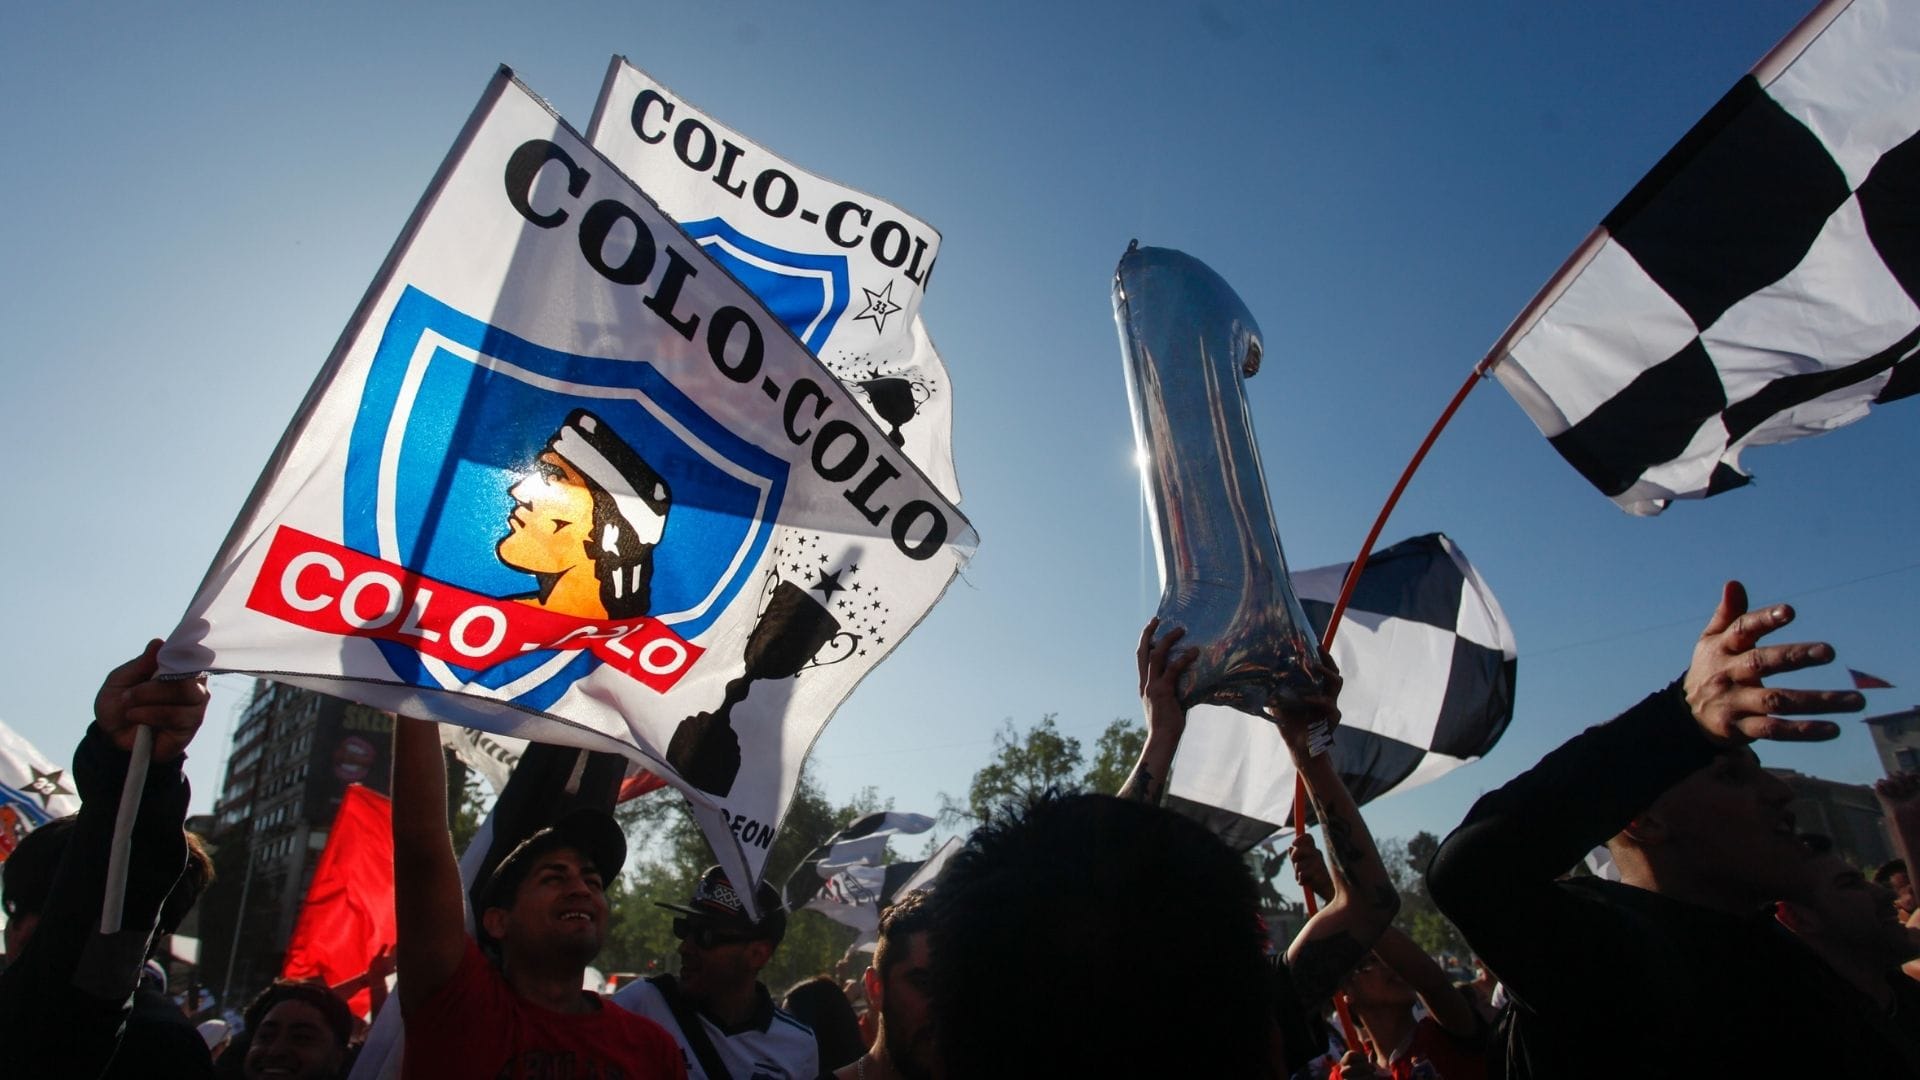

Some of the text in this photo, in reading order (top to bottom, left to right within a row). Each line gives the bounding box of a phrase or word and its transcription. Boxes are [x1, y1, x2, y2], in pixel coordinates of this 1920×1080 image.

[630, 89, 937, 294] COLO-COL
[503, 138, 949, 561] COLO-COLO
[872, 300, 887, 314] 33
[720, 807, 776, 850] EON
